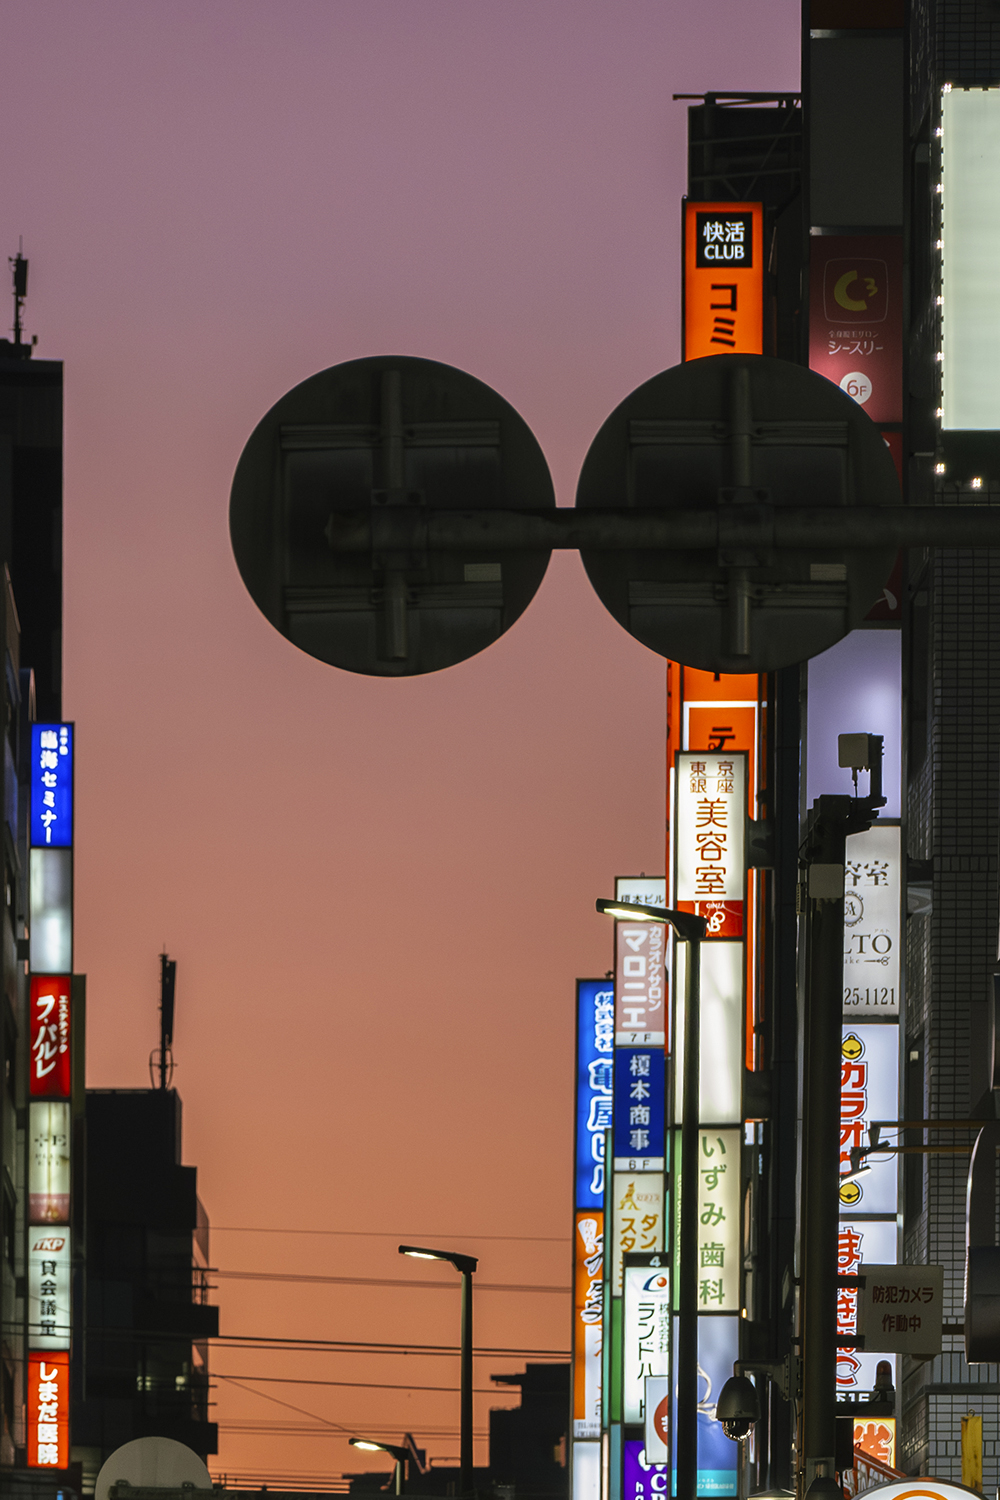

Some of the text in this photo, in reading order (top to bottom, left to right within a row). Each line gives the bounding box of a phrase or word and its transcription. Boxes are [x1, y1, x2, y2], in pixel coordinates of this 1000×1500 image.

[703, 221, 745, 243] 快活
[704, 244, 744, 260] CLUB
[828, 340, 884, 356] シースリー
[847, 379, 866, 397] 6F
[690, 761, 734, 777] 東京
[690, 778, 734, 795] 銀座
[694, 797, 728, 895] 美容室
[648, 925, 663, 1013] カラオケサロン
[621, 929, 649, 1029] マロニエ
[630, 1054, 651, 1151] 榎本商事
[699, 1136, 727, 1305] いずみ歯科
[34, 1237, 64, 1251] TKP
[872, 1285, 934, 1304] 防犯カメラ
[882, 1314, 922, 1333] 作動中
[38, 1362, 59, 1465] しまだ医院
